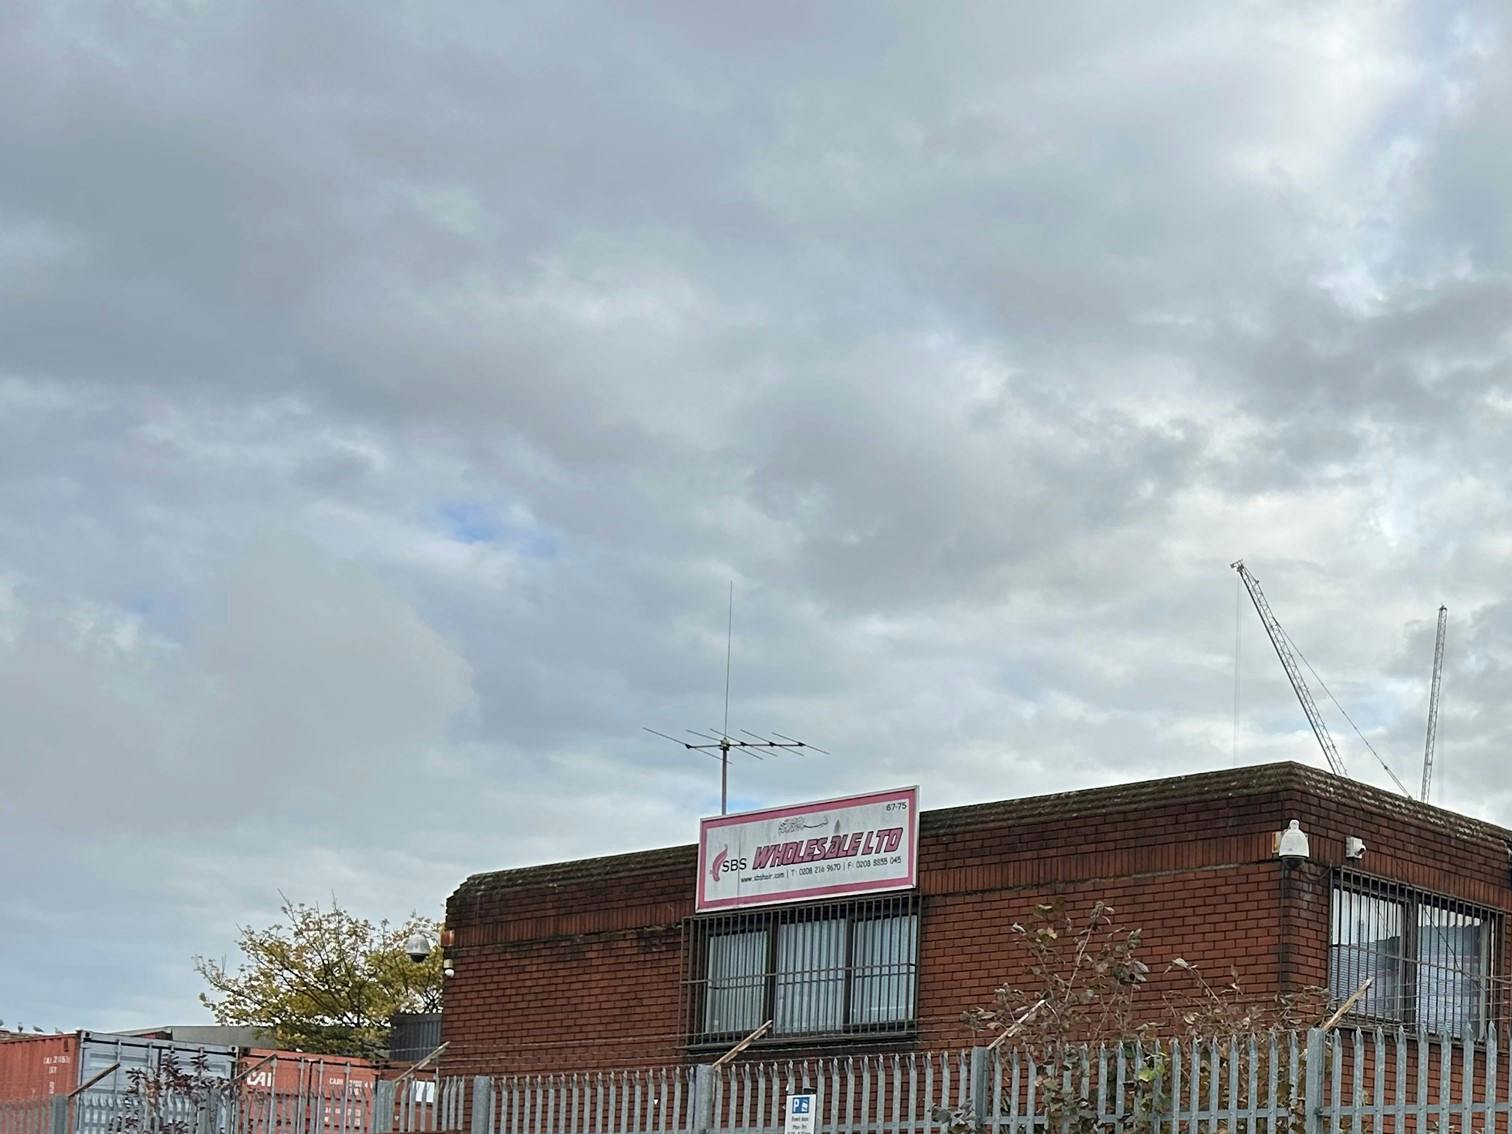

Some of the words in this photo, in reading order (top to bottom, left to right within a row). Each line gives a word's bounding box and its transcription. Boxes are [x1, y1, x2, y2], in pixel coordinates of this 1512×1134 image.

[886, 802, 908, 811] 67-75
[722, 858, 747, 872] SBS
[861, 827, 904, 856] LTD
